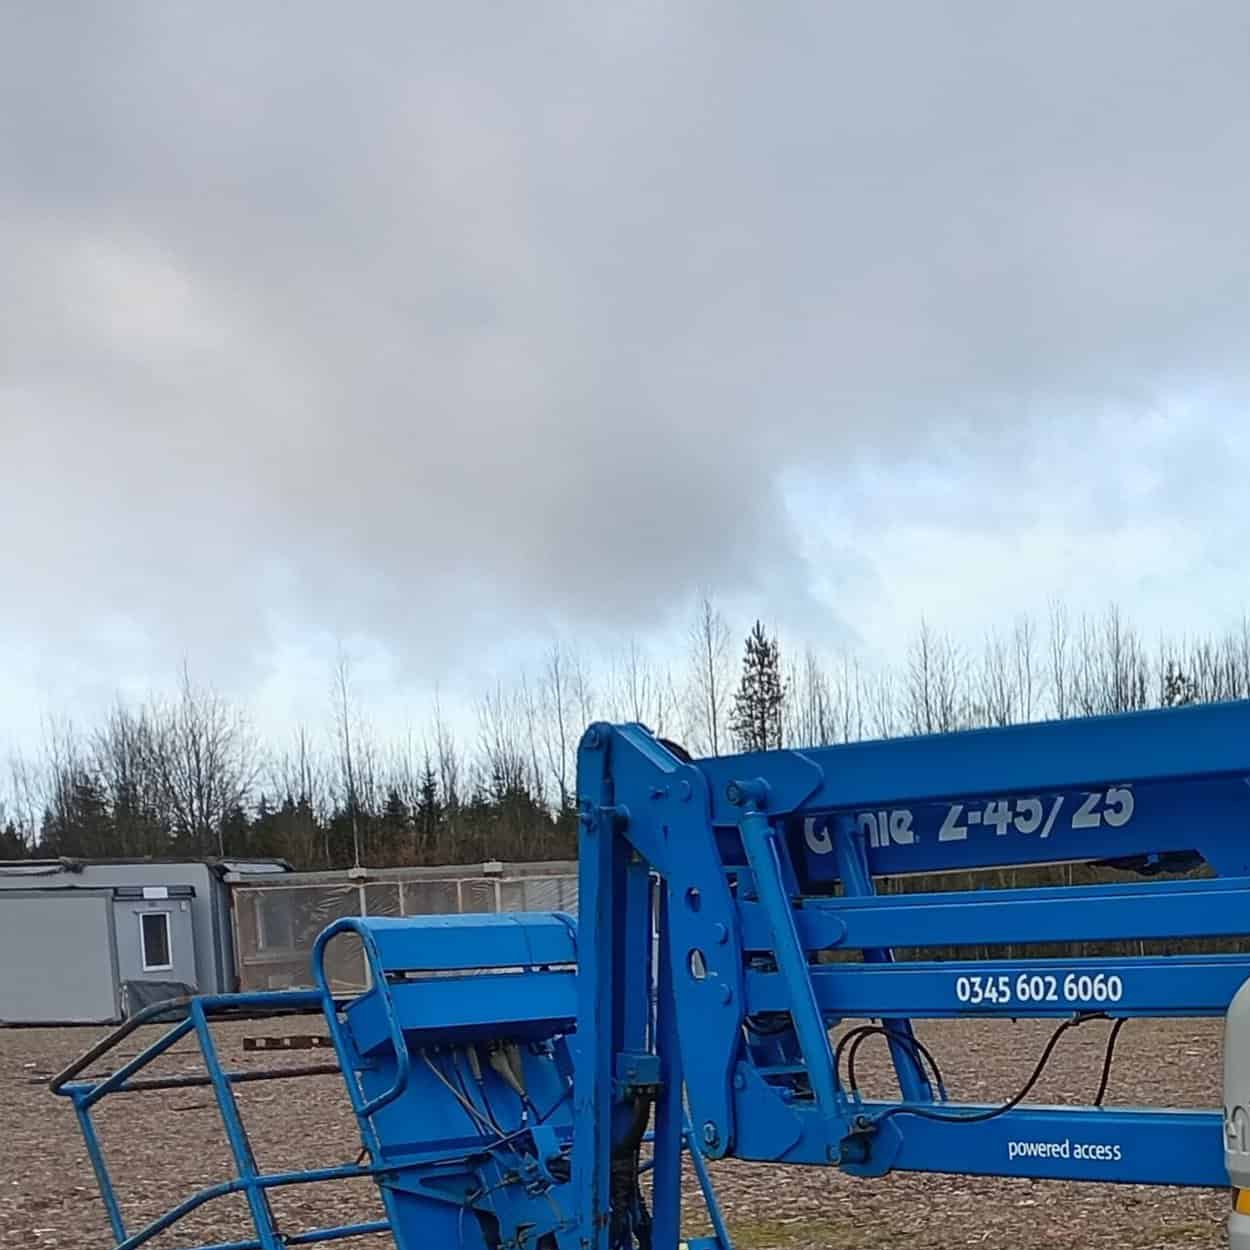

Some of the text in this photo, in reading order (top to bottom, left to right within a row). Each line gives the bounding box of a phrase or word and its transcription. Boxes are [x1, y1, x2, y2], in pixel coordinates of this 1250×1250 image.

[804, 809, 915, 854] Gnie
[956, 974, 1123, 1003] 0345 602 6060
[1008, 1138, 1121, 1160] powered access
